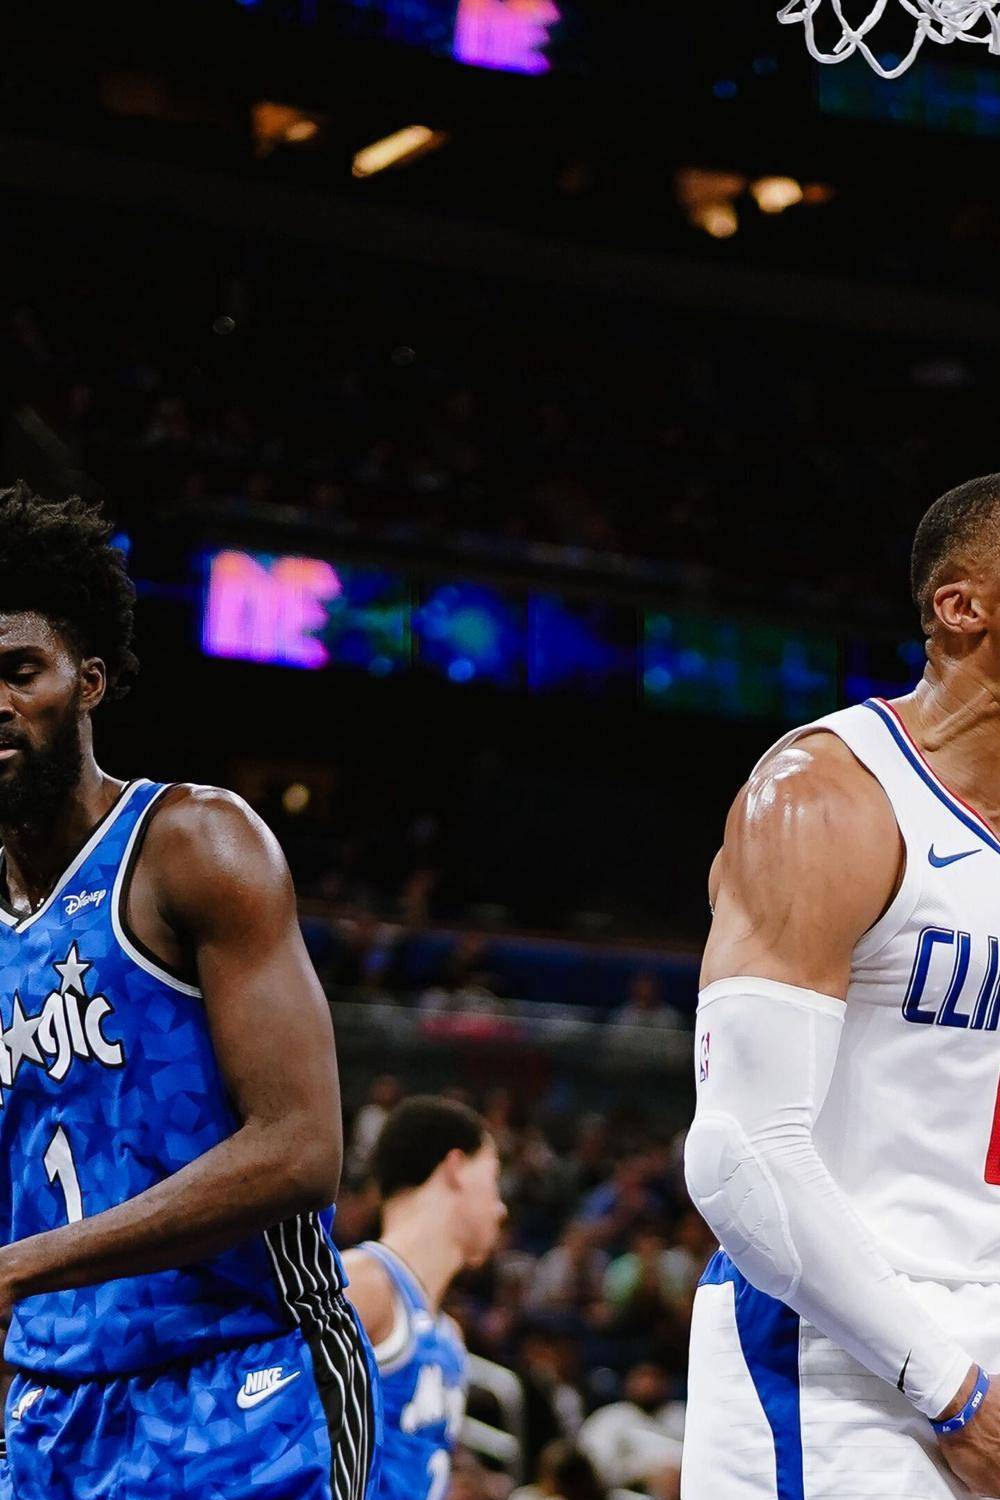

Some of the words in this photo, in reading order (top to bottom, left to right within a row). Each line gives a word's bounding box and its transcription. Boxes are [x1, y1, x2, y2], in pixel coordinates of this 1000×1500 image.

[62, 889, 107, 916] Disney
[0, 942, 124, 1087] agic
[43, 1124, 83, 1224] 1
[244, 1366, 283, 1394] NIKE
